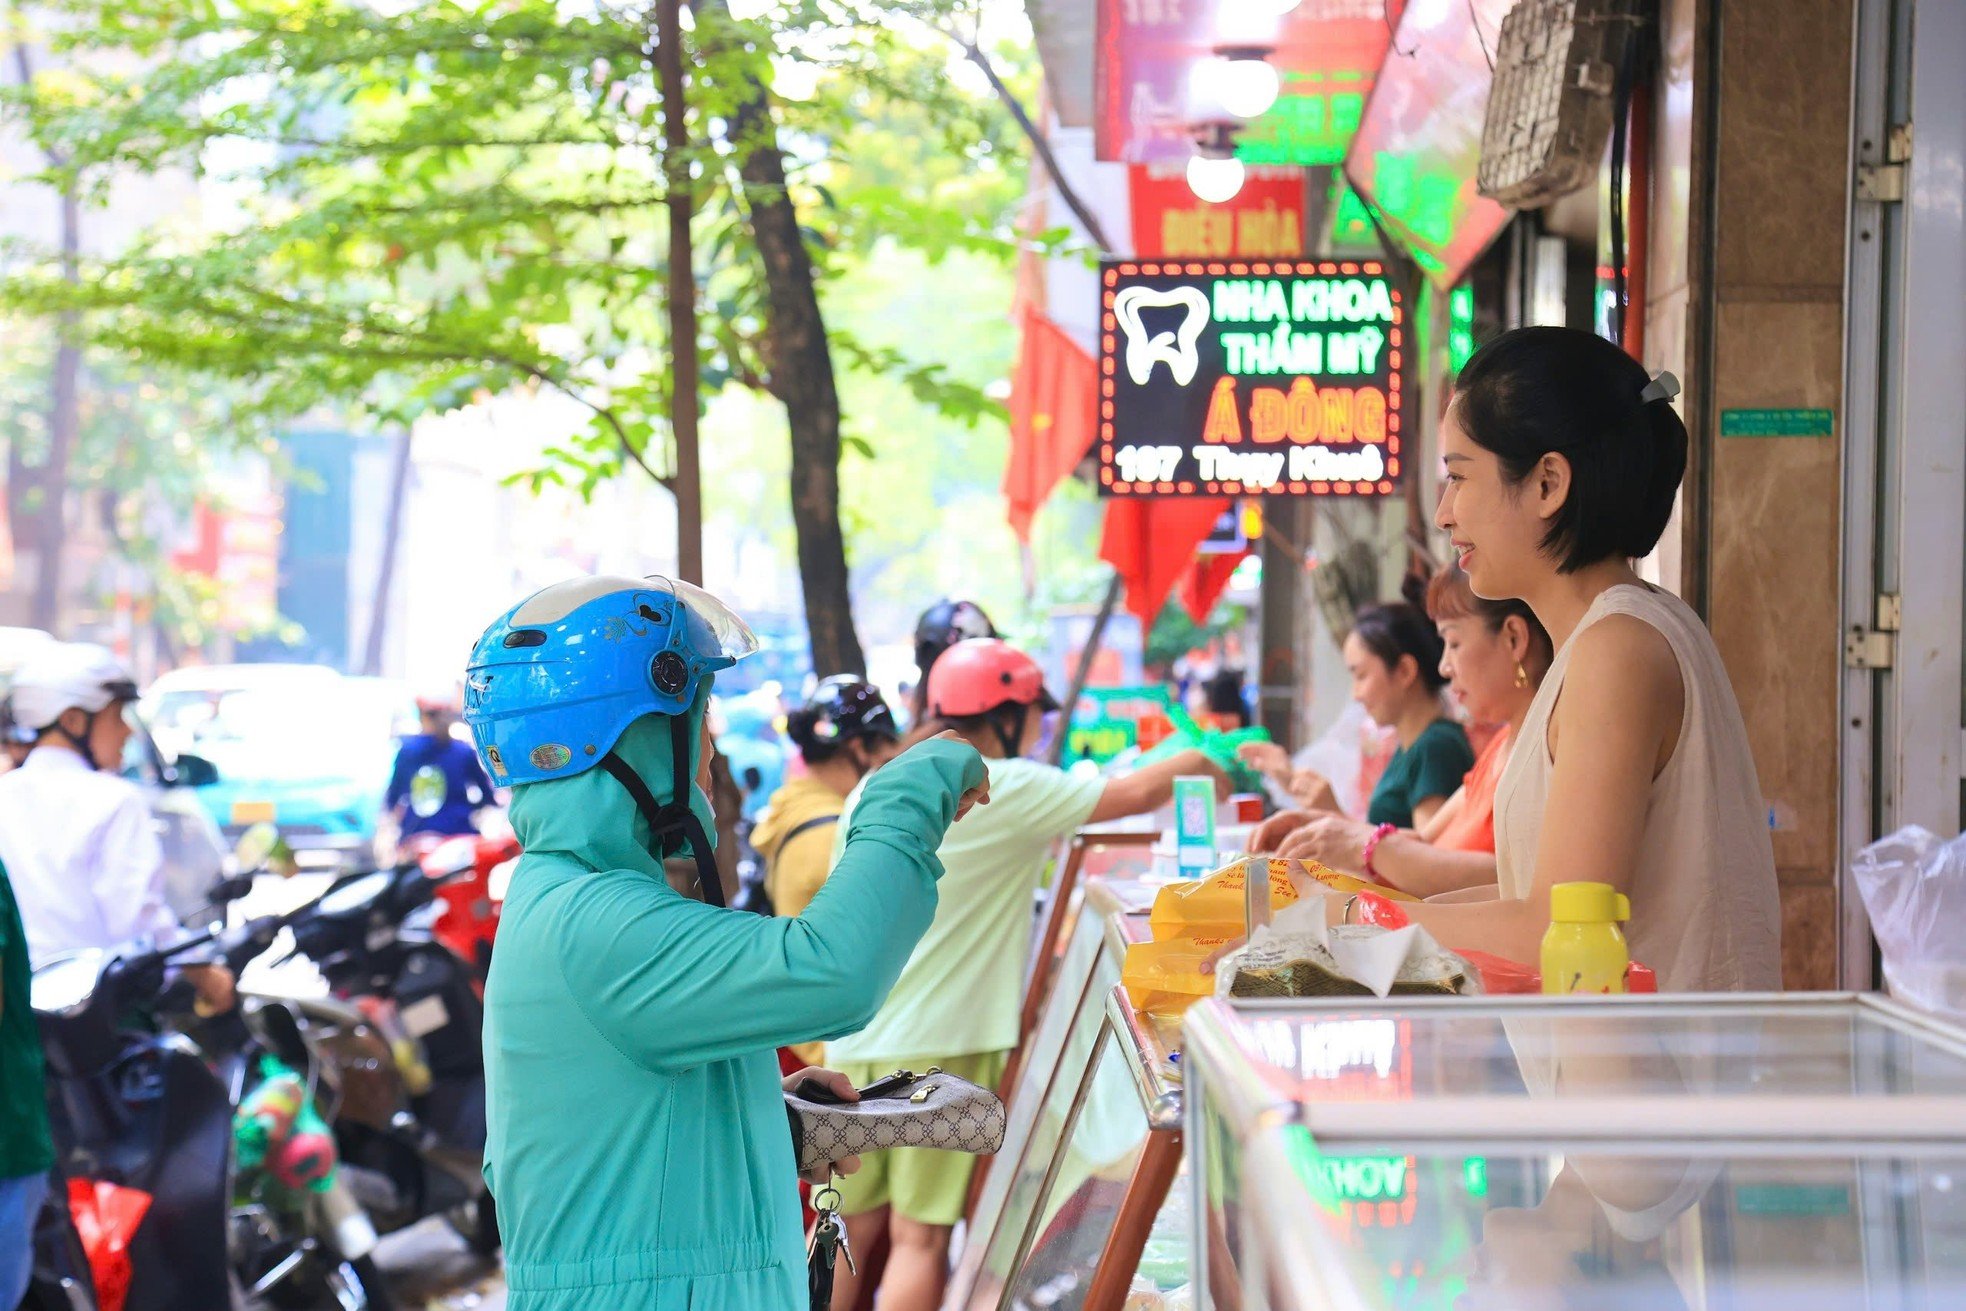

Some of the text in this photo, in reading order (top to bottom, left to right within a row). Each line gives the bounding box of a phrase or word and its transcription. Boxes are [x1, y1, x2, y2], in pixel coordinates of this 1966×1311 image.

[1213, 279, 1394, 322] NHA KHOA
[1204, 376, 1387, 443] Á ĐÔNG
[1193, 937, 1225, 946] Thanks
